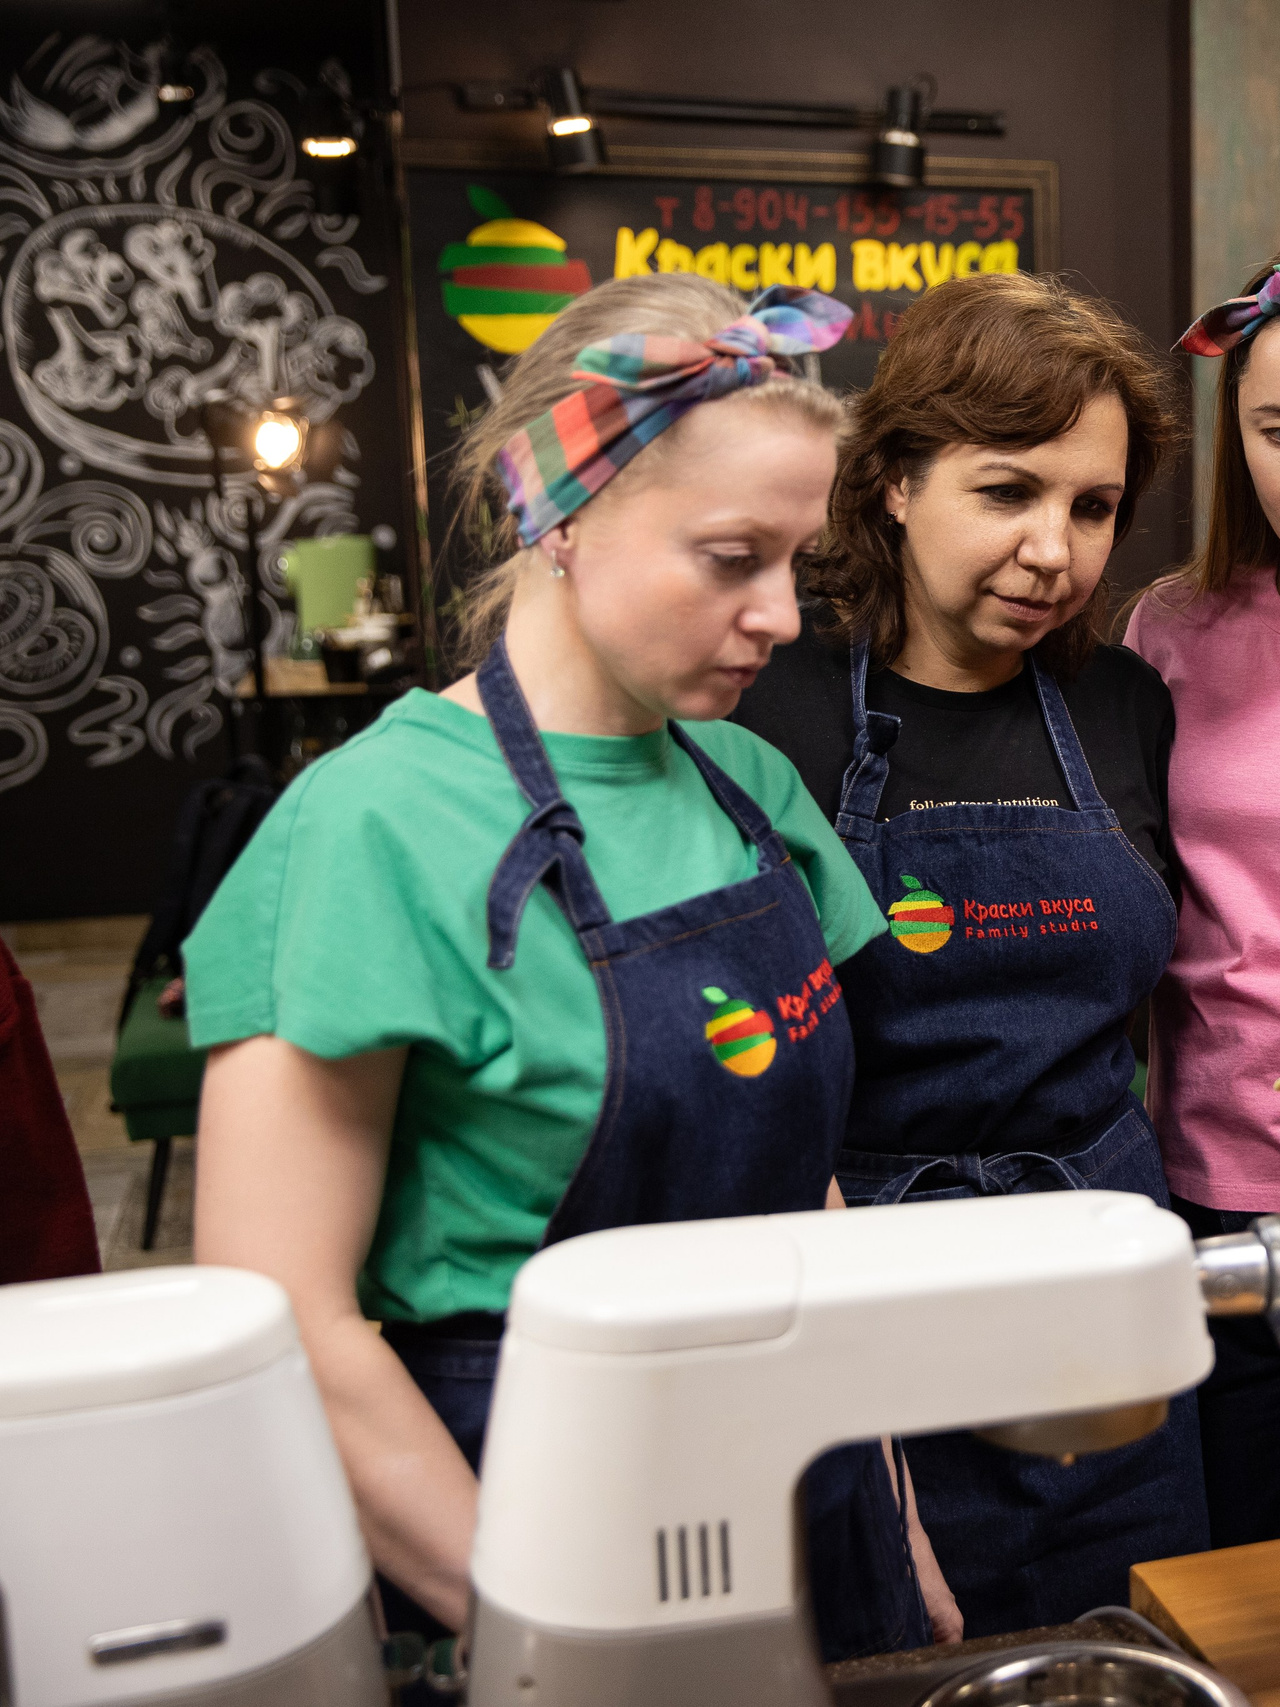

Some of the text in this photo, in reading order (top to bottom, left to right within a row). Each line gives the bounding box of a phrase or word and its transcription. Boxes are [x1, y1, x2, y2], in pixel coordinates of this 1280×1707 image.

[909, 799, 957, 811] follow
[963, 898, 1095, 925] Краски вкуса
[965, 919, 1098, 938] Family studio
